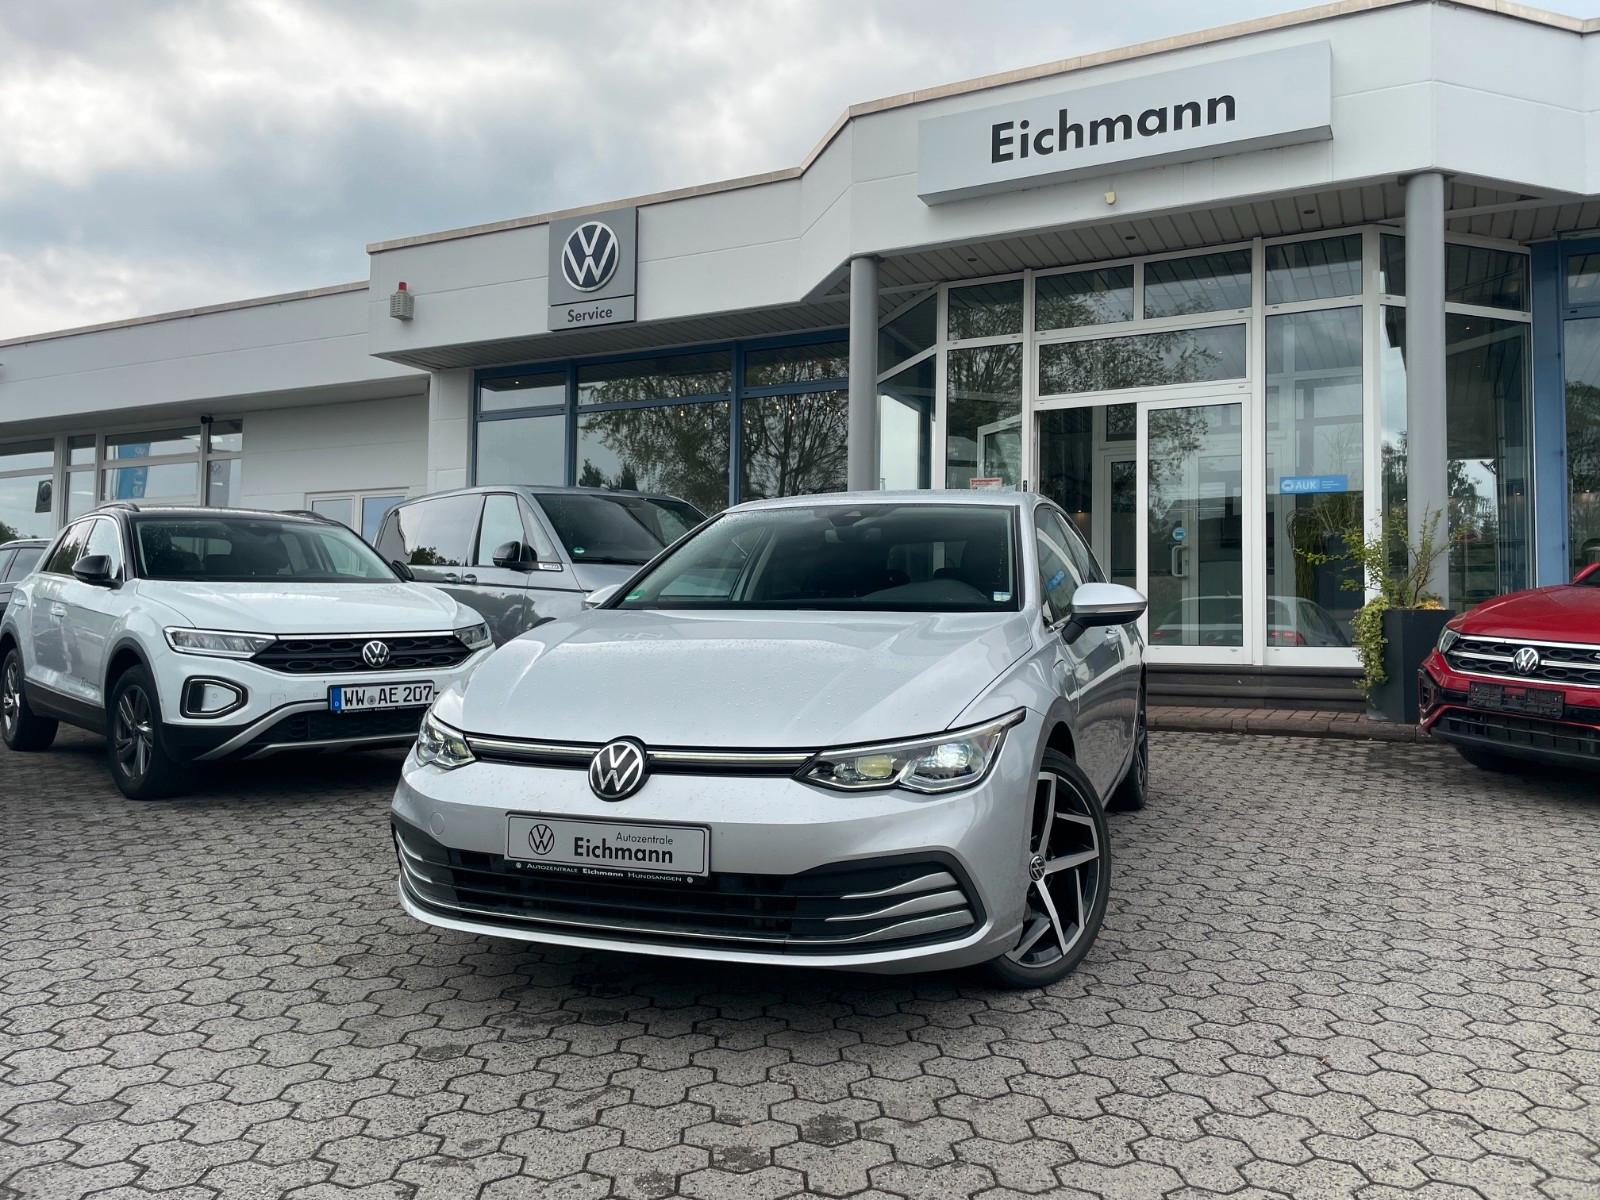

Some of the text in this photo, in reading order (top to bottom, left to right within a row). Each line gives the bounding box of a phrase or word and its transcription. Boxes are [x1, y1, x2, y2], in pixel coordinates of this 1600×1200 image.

[991, 94, 1236, 164] Eichmann
[561, 221, 619, 292] VW
[567, 307, 613, 323] Service
[344, 685, 433, 707] WW AE 207
[589, 740, 644, 799] VW
[528, 824, 555, 855] VW
[573, 836, 673, 864] Eichmann
[615, 831, 674, 846] Autozentrale
[582, 868, 624, 878] Eichmann
